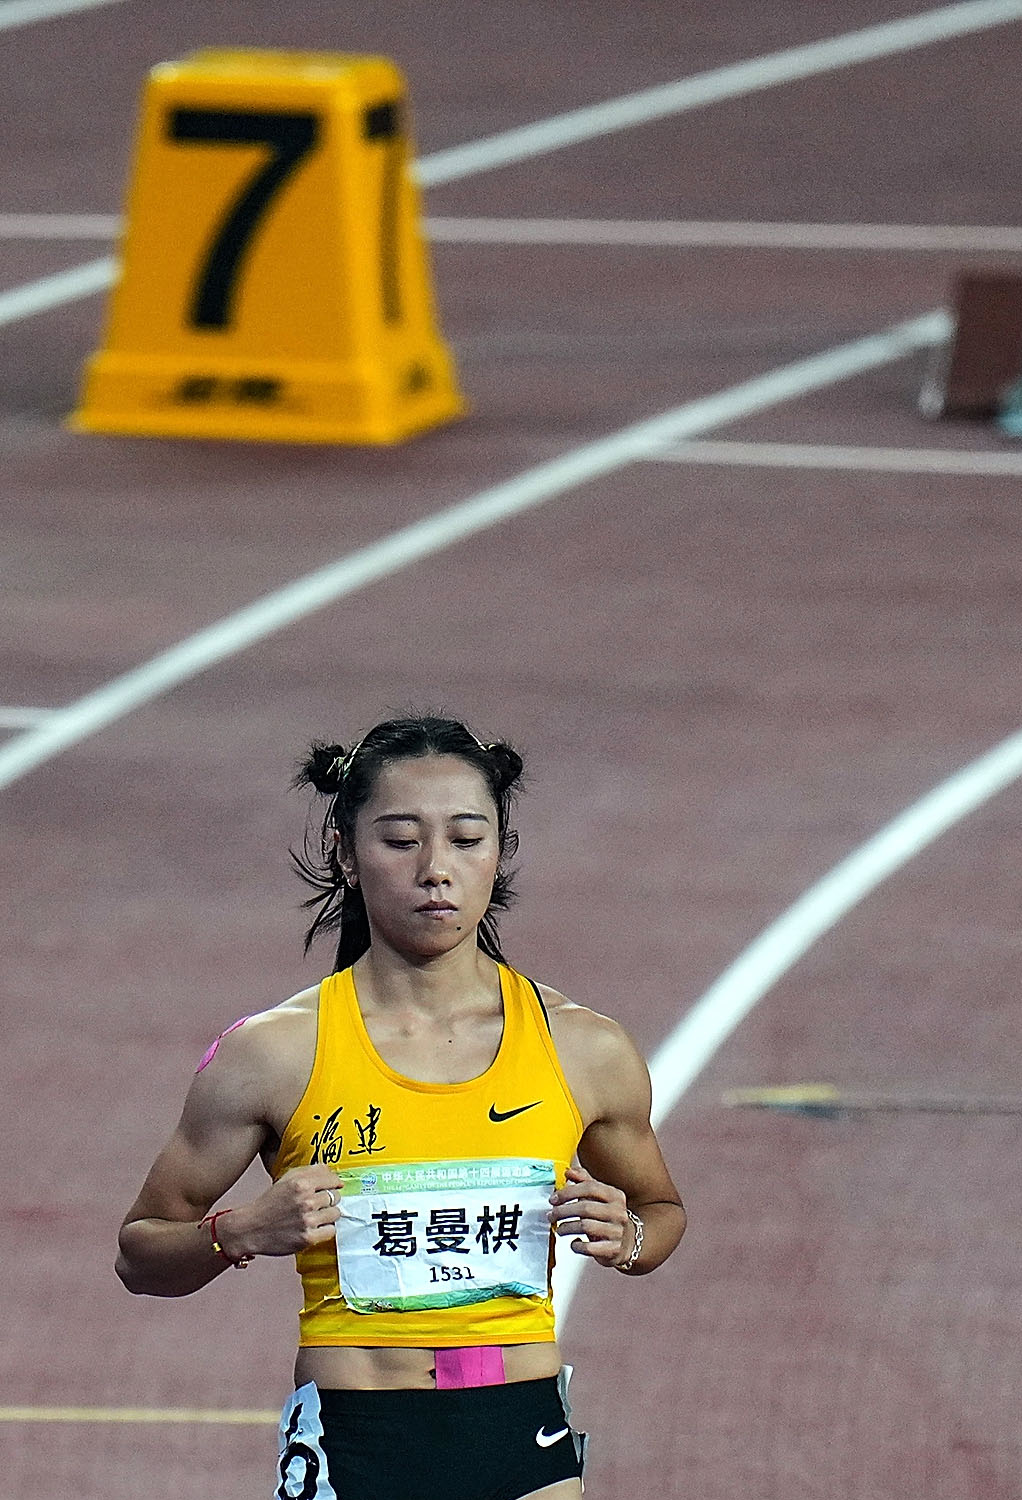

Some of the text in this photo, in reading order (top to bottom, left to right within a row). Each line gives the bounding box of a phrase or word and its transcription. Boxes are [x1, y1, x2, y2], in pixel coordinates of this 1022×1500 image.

[168, 106, 320, 330] 7
[309, 1104, 386, 1166] 福建
[371, 1204, 523, 1257] 葛曼棋
[429, 1266, 475, 1283] 1531
